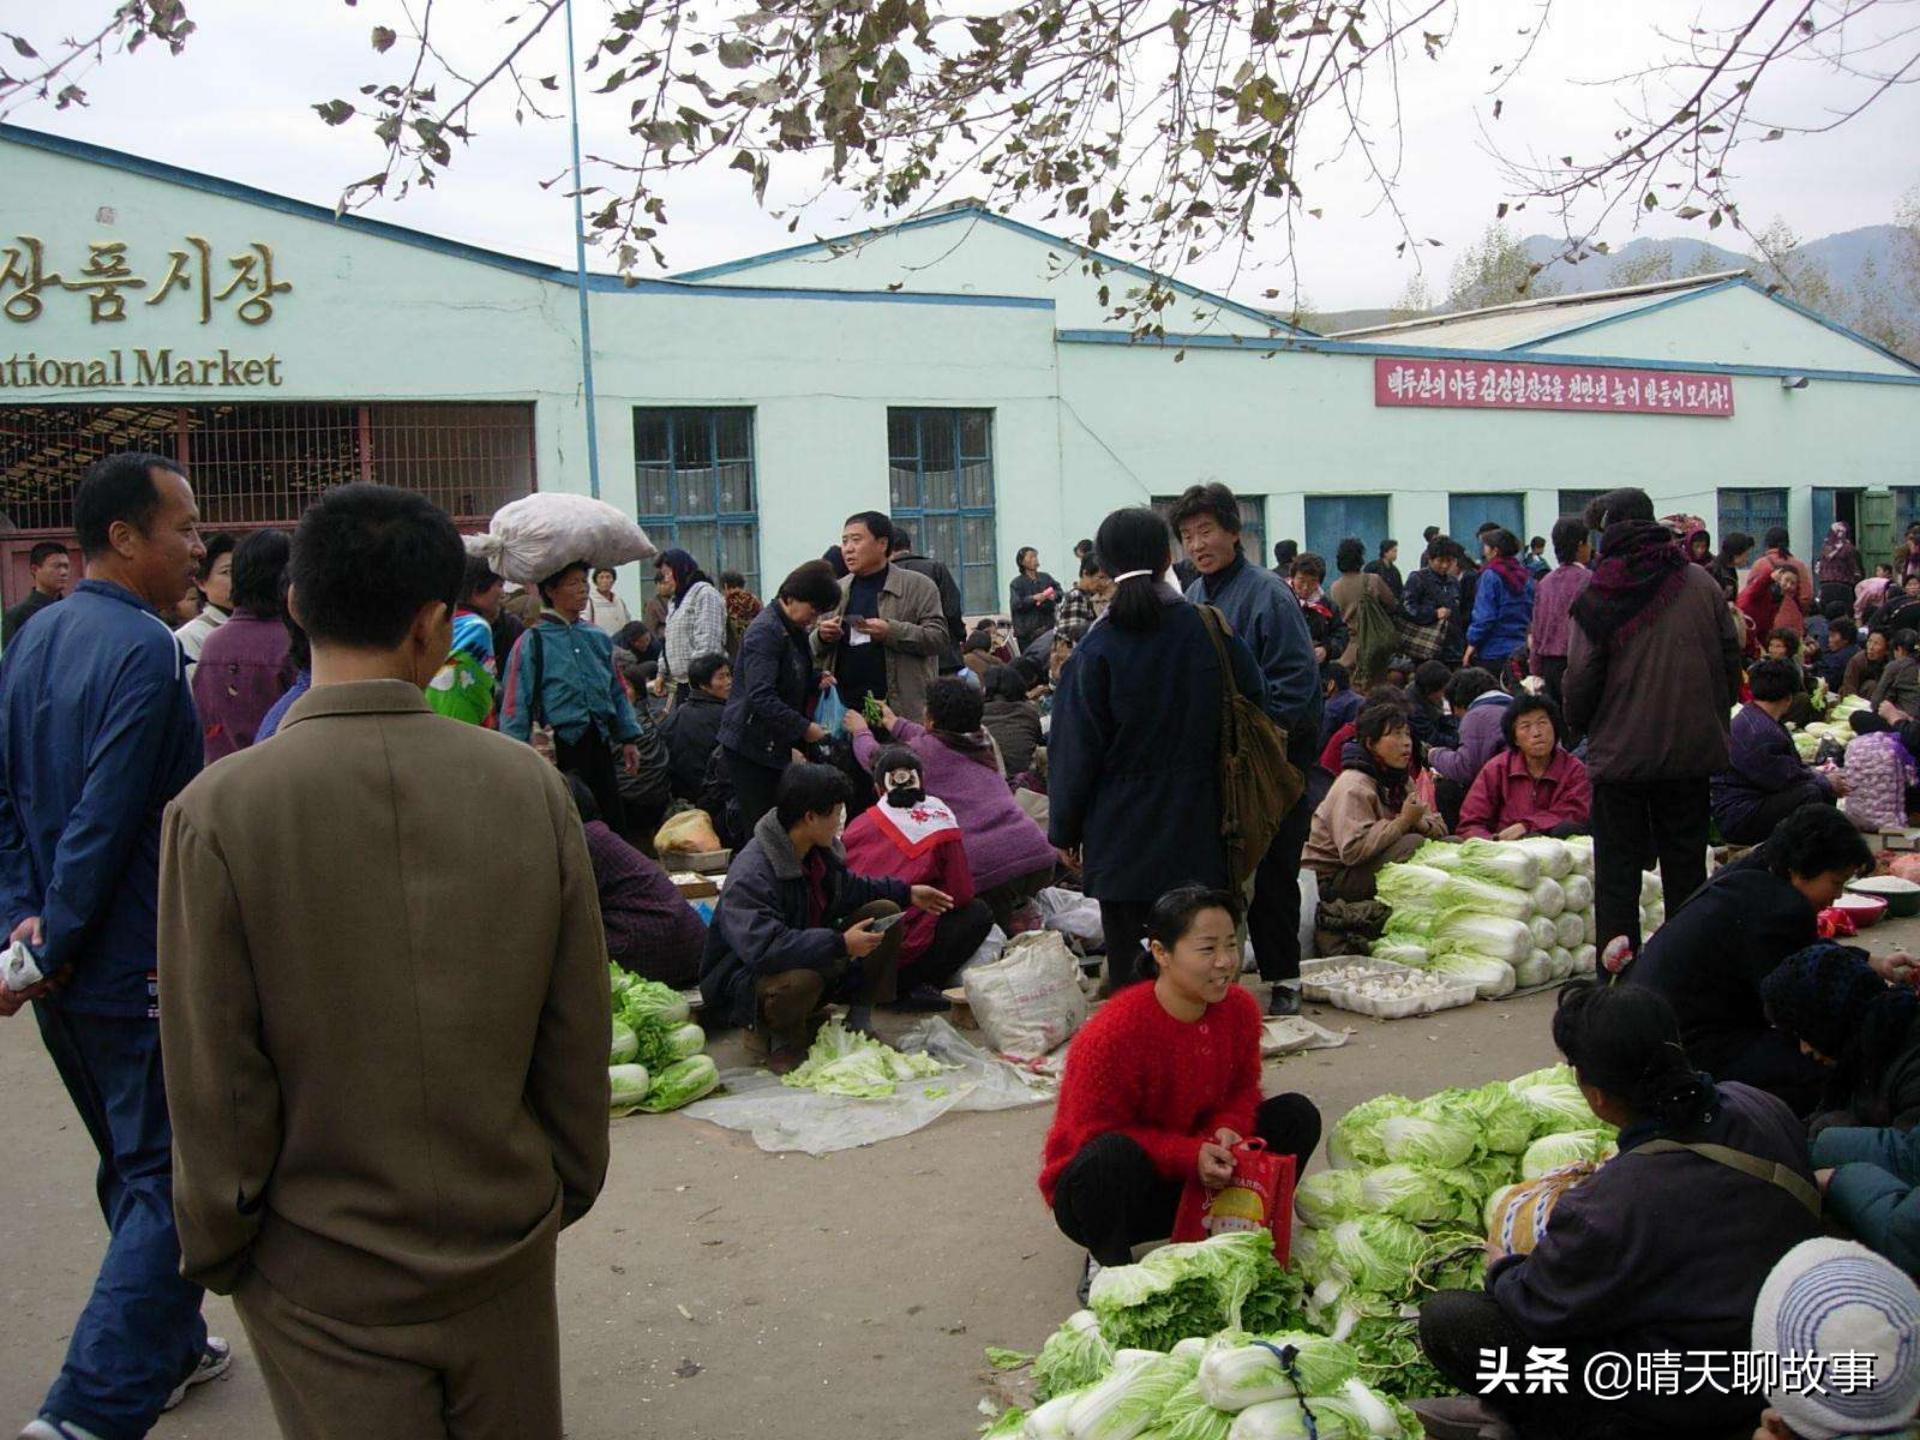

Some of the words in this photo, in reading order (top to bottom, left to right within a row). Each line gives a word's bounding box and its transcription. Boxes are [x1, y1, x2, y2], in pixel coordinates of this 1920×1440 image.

[133, 350, 283, 388] Market
[1388, 365, 1445, 400] 백두산의
[1449, 369, 1477, 401] 아들
